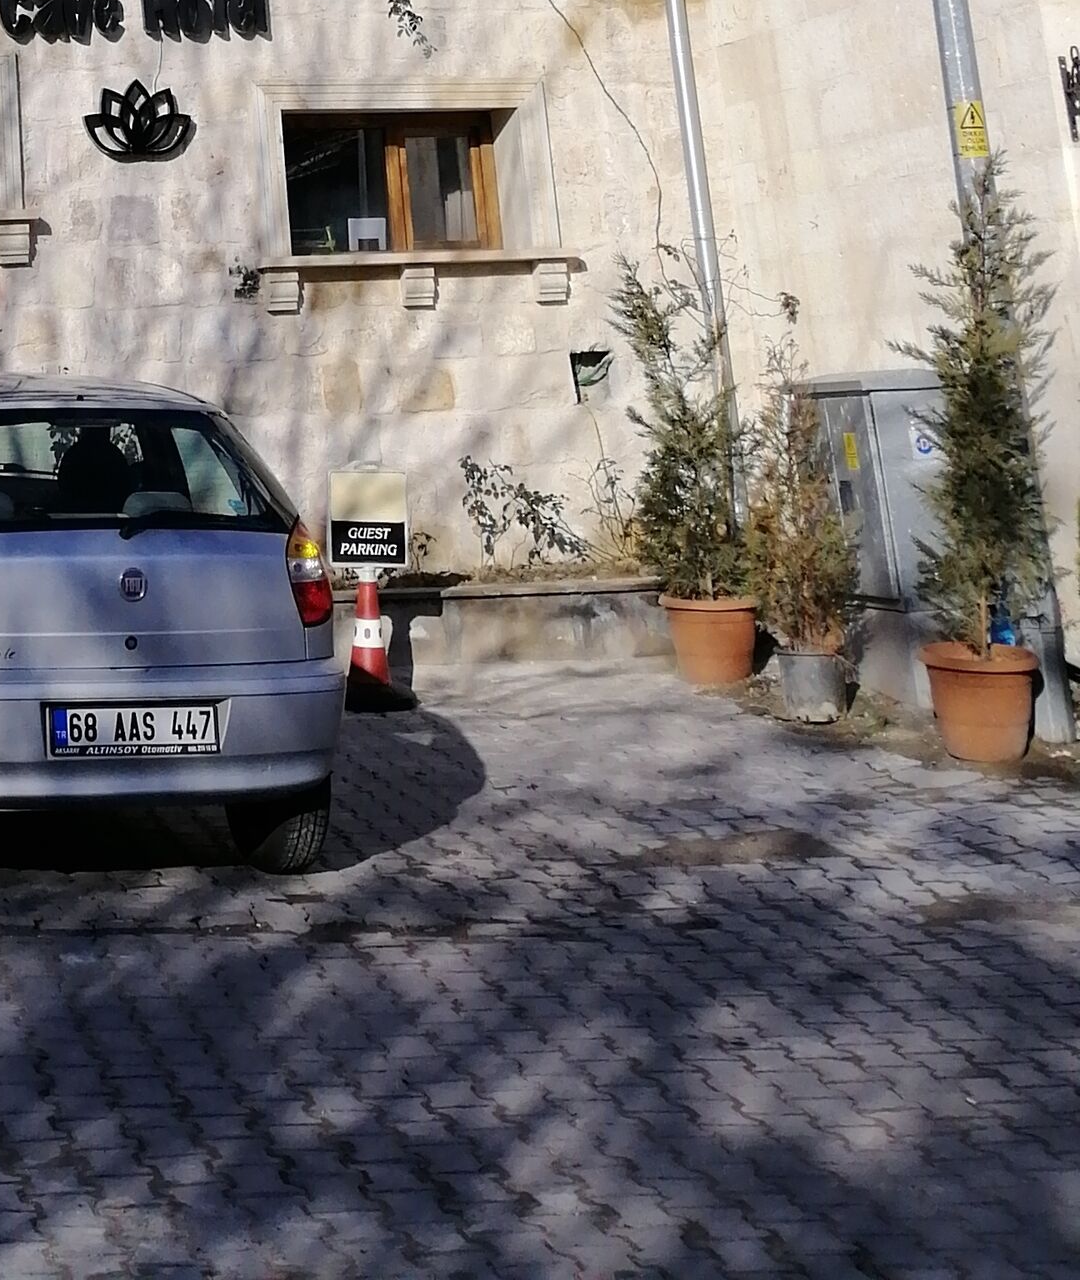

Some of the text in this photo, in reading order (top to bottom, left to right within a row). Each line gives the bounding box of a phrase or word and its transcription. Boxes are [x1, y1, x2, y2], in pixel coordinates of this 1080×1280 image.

[348, 527, 391, 539] GUEST
[340, 543, 397, 556] PARKING
[56, 711, 210, 742] TR 68 AAS 447
[86, 746, 138, 754] ALTINSOY
